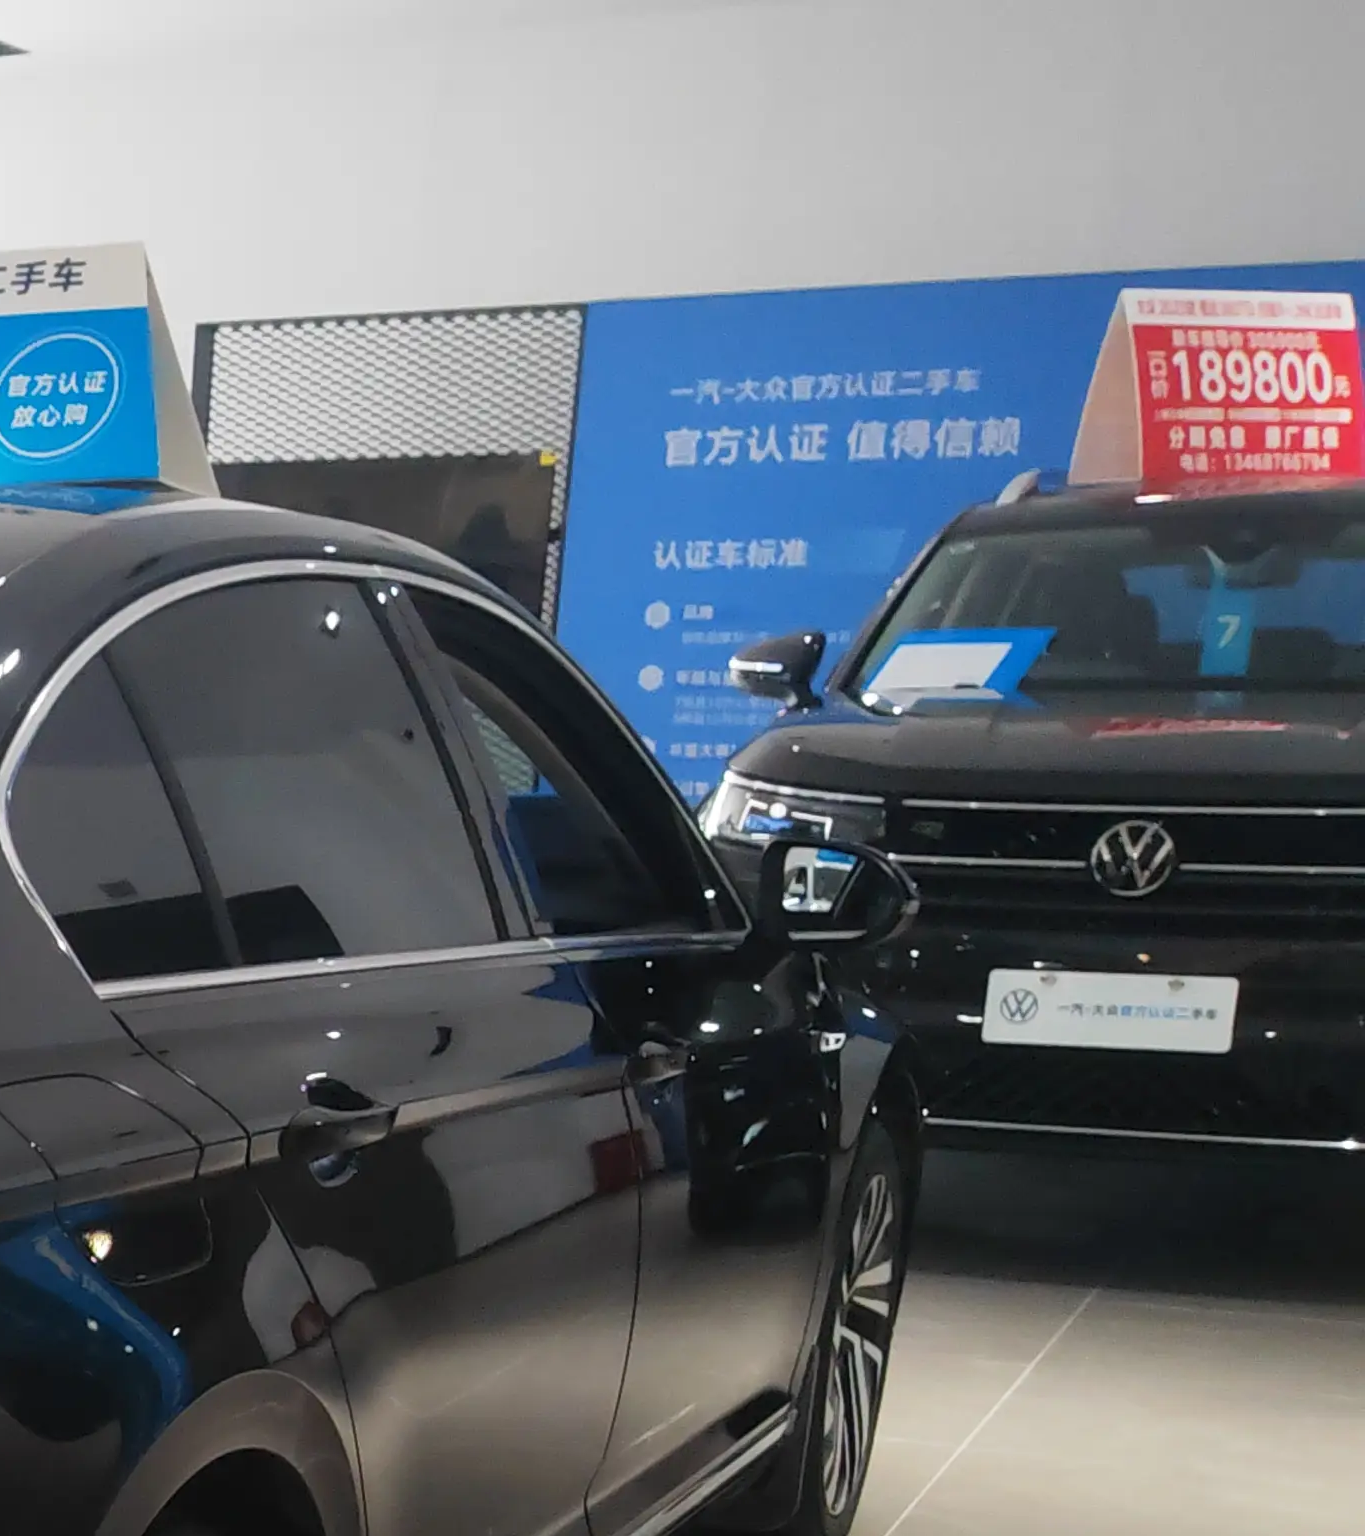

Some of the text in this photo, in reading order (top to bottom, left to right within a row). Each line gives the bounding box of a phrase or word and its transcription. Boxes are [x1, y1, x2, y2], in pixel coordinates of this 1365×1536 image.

[8, 370, 109, 398] 官方认证
[670, 368, 981, 404] 一汽-大众官方认证二手车
[10, 402, 89, 430] 放心购
[664, 416, 1020, 468] 官方认证 值得信赖
[653, 537, 809, 570] 认证车标准
